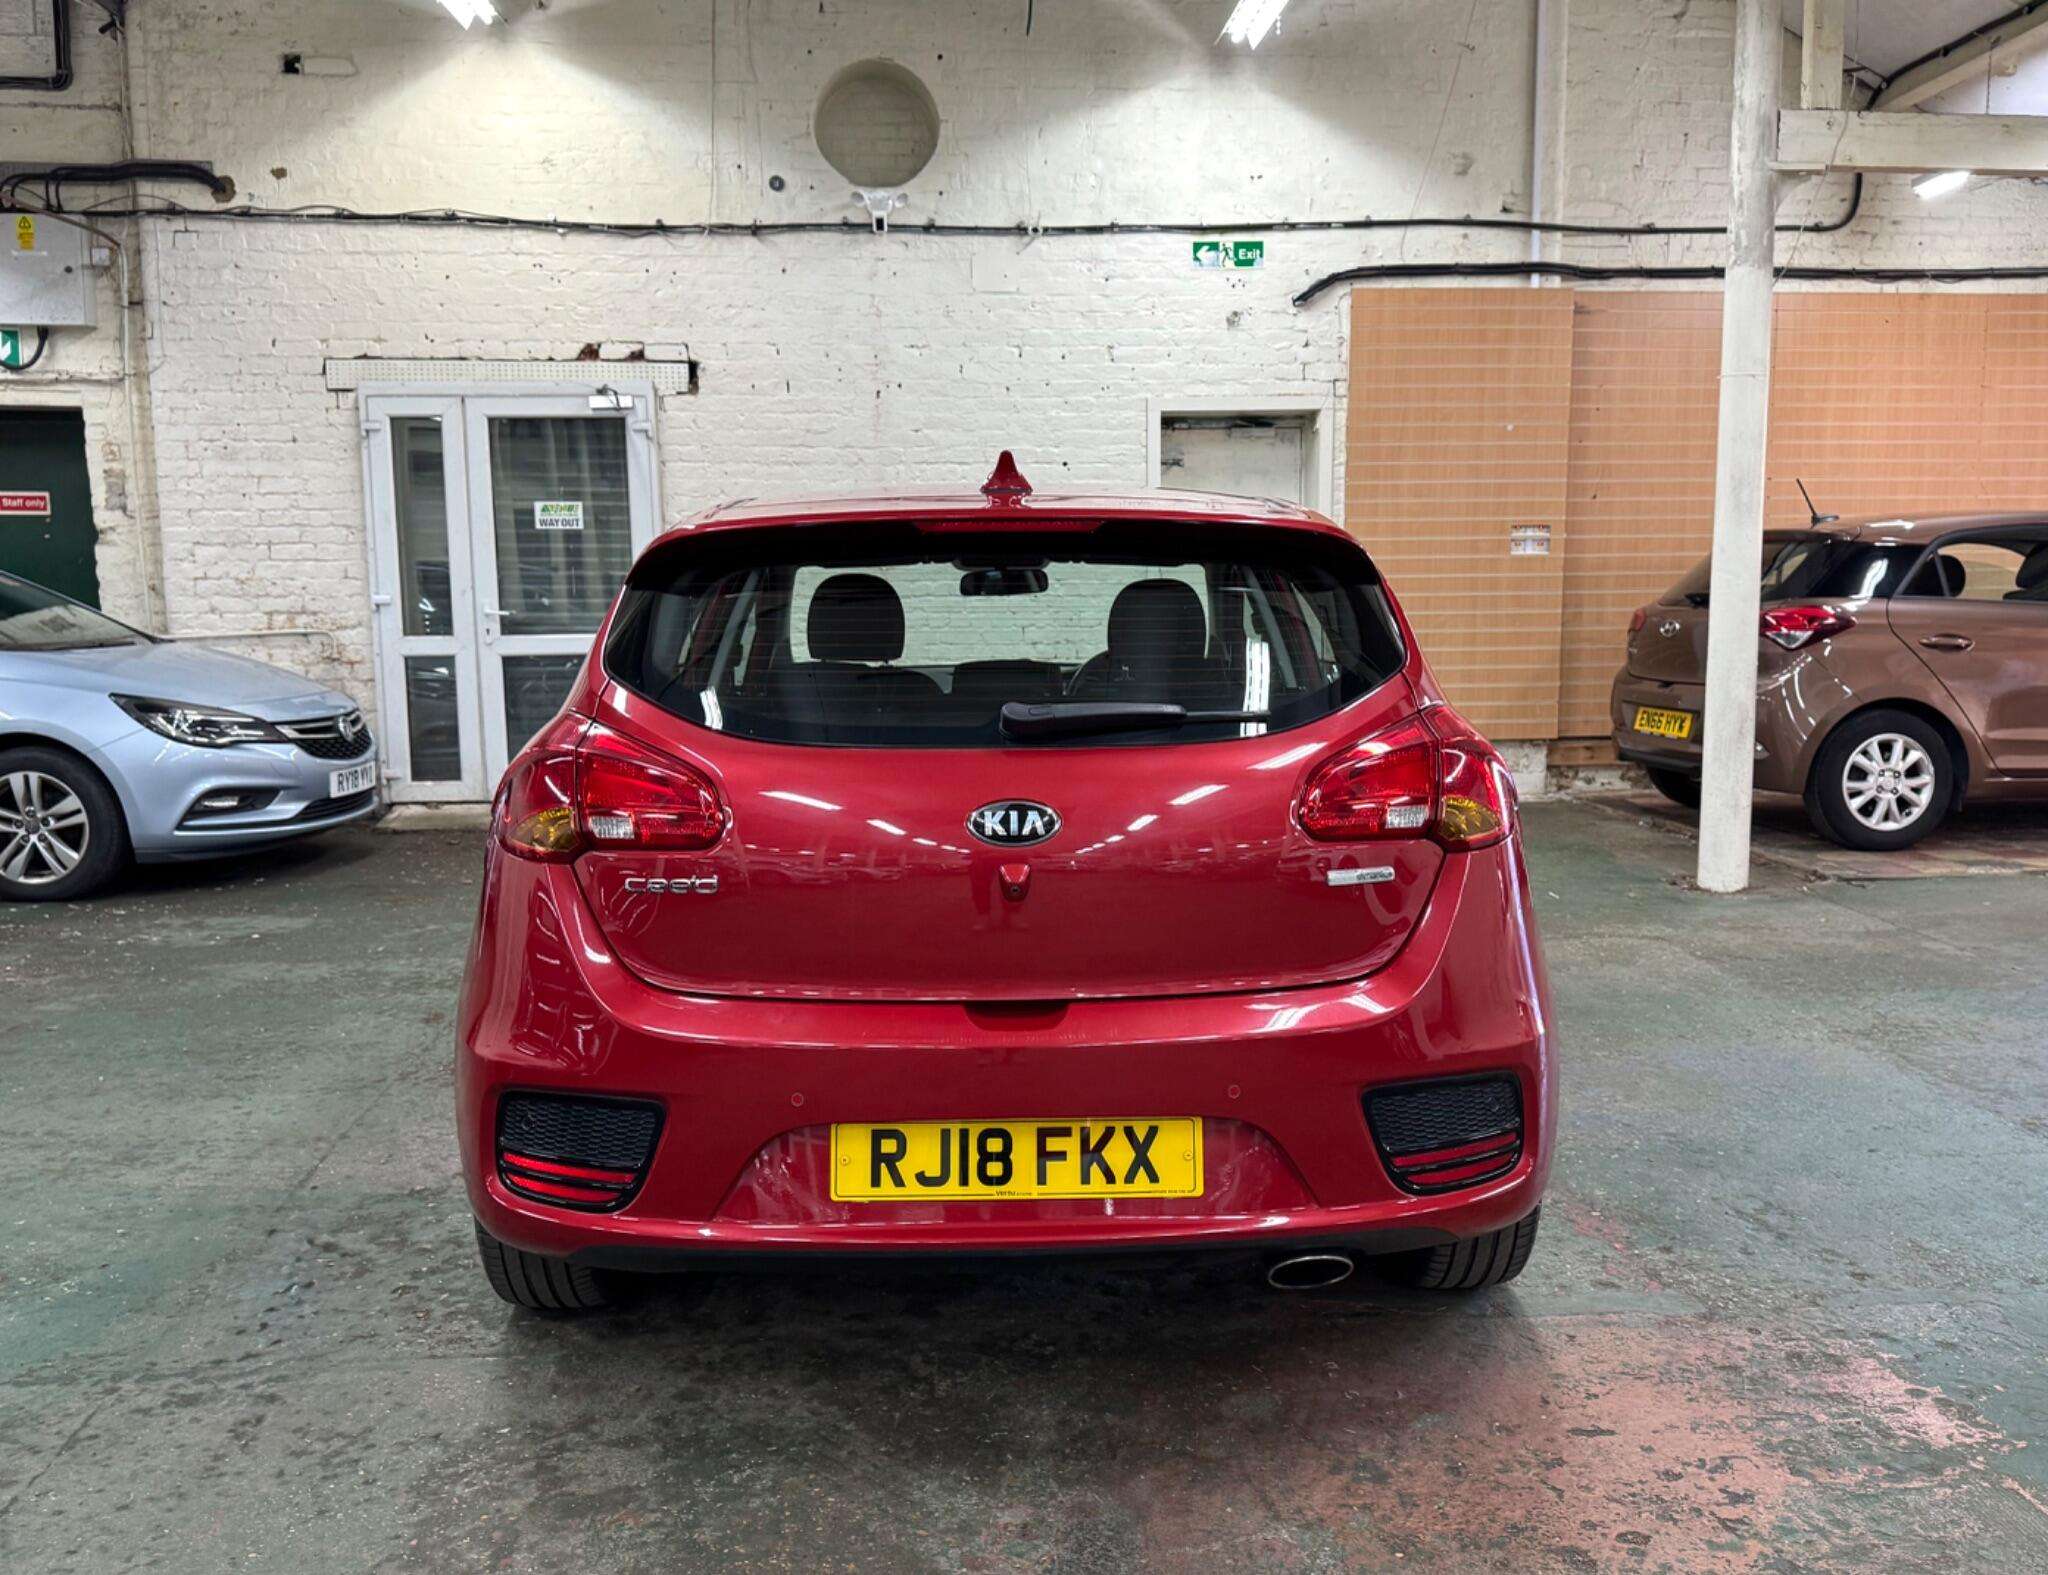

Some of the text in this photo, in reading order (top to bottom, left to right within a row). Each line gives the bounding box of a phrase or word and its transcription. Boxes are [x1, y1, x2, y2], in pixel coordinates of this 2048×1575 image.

[1238, 248, 1261, 260] Exit
[25, 498, 46, 509] only
[539, 518, 580, 527] WAY OUT
[337, 769, 360, 793] RY18
[984, 810, 1046, 836] KIA
[870, 1125, 1160, 1188] RJ18 FKX
